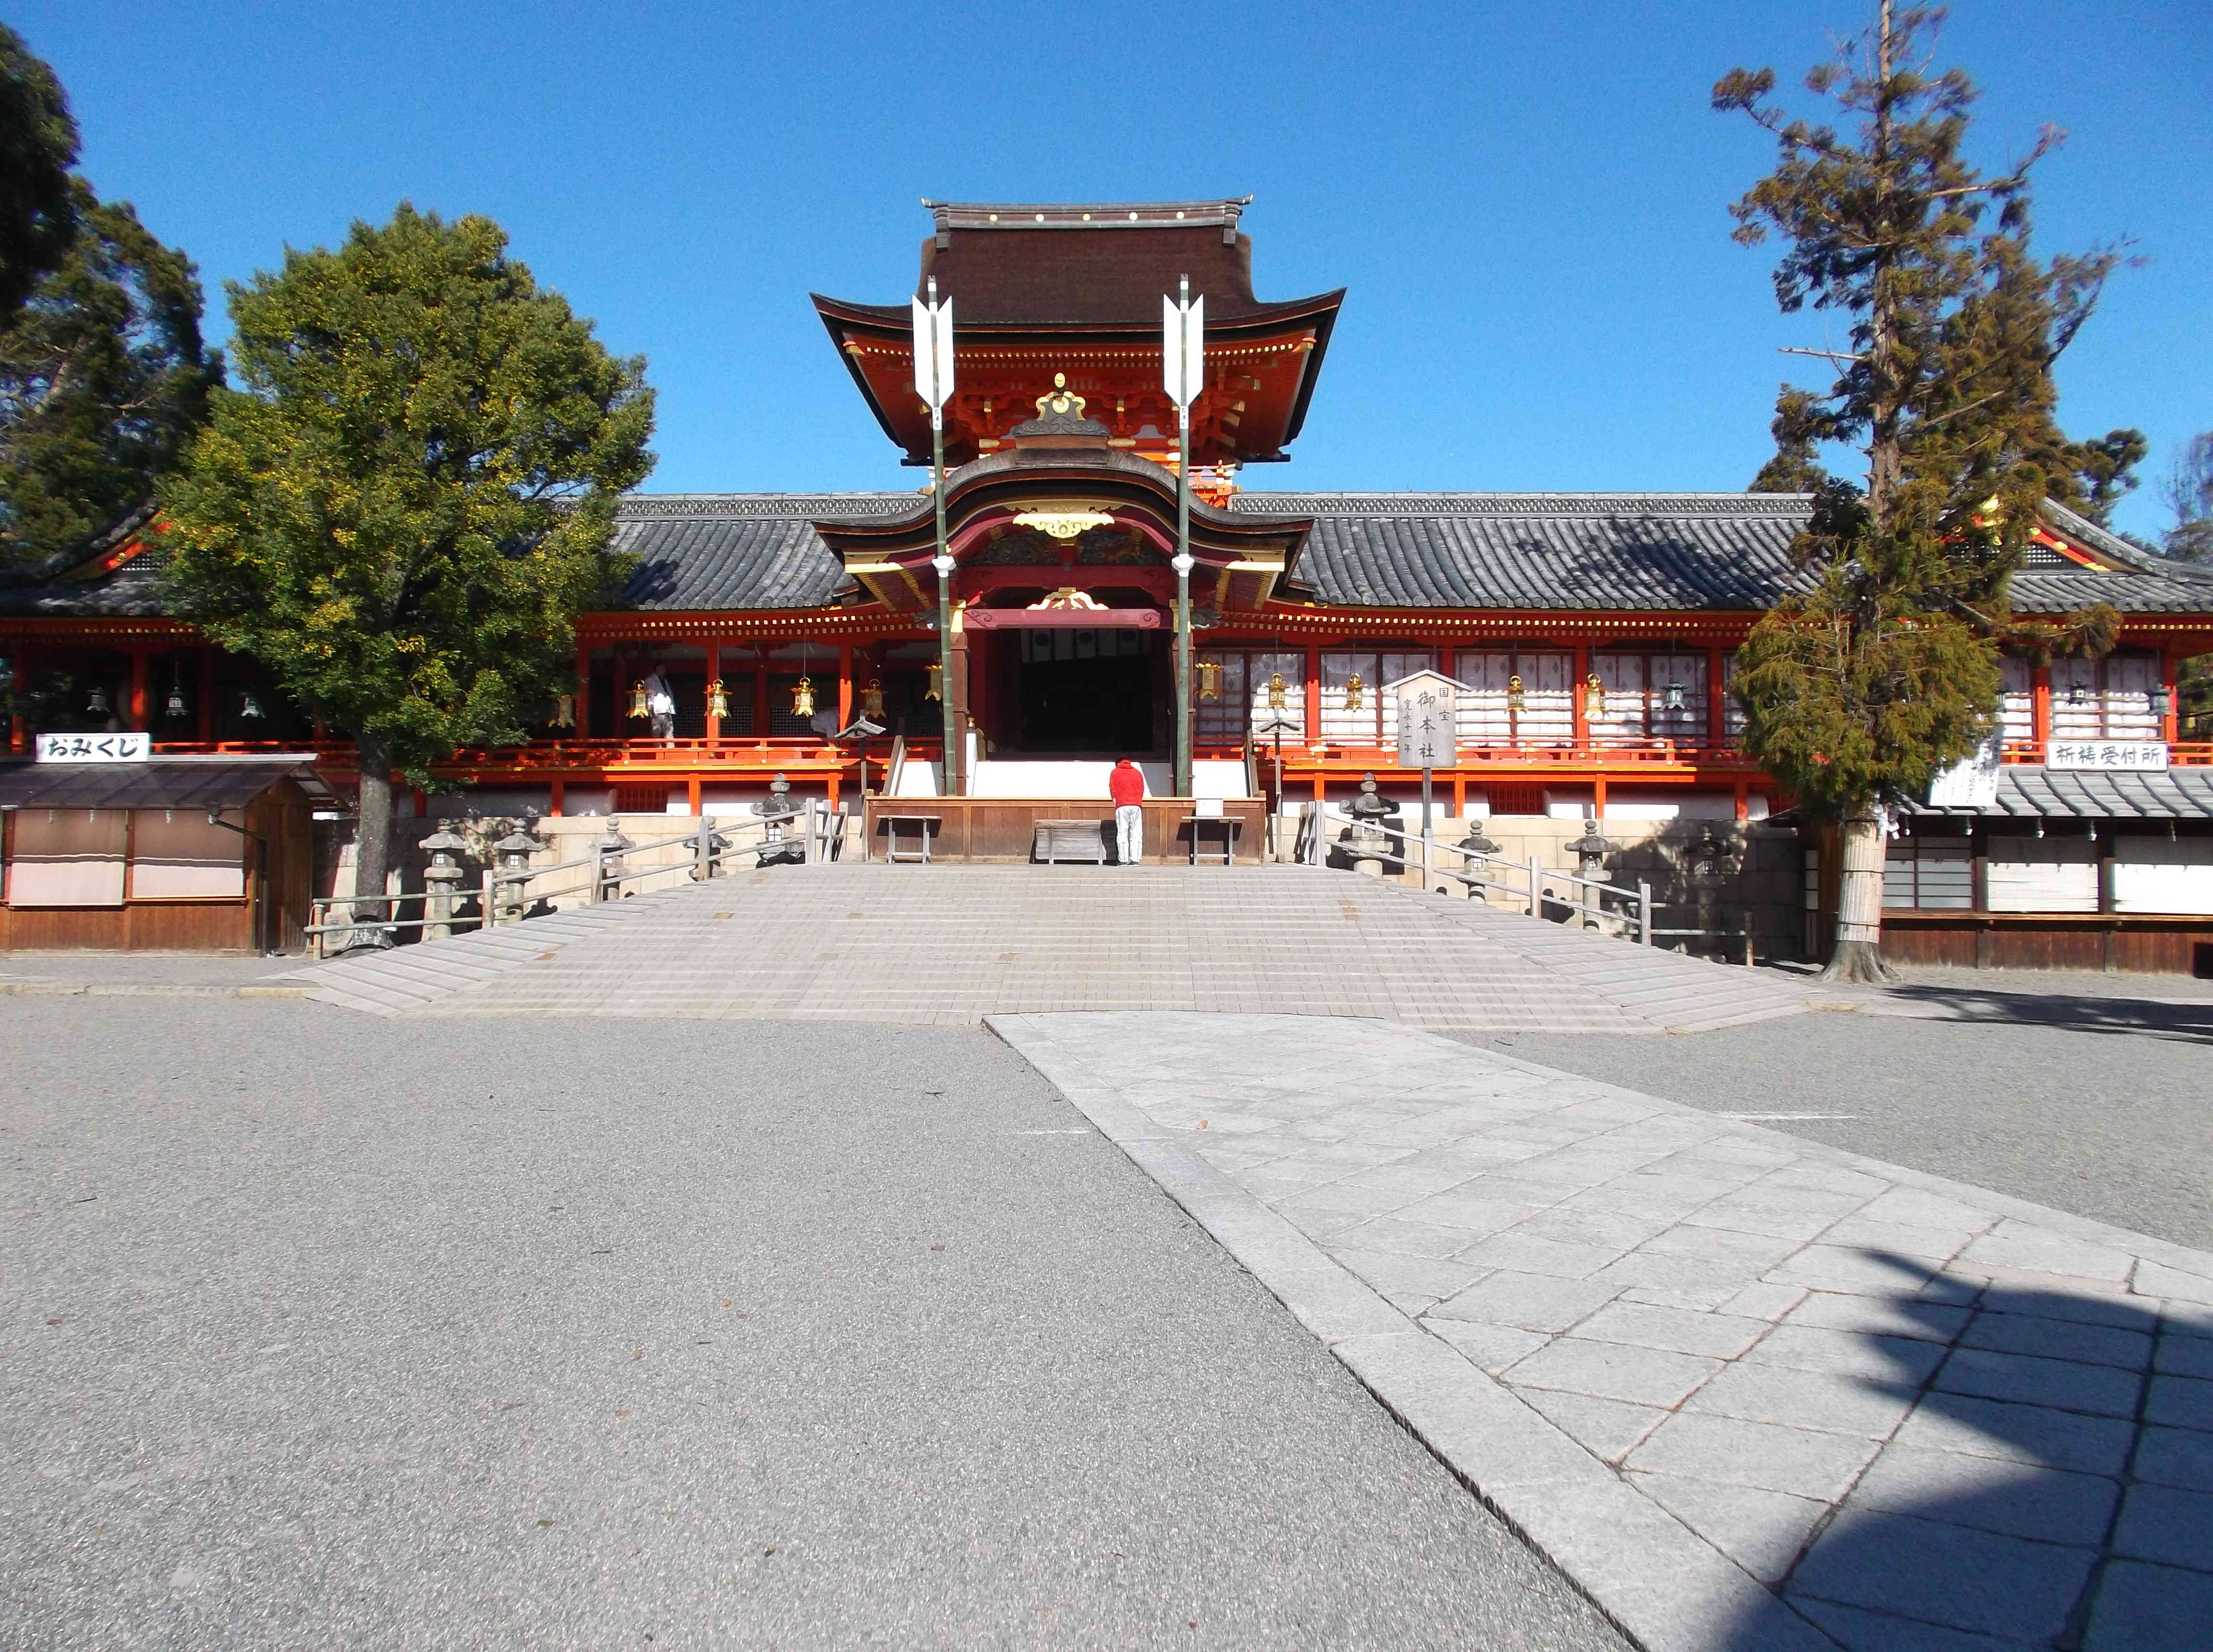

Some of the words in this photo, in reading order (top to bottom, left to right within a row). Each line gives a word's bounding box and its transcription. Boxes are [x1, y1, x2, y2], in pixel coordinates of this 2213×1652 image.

[1439, 687, 1450, 721] 国宝
[1403, 699, 1412, 753] 寛永十一年
[1417, 690, 1436, 758] 御本社
[49, 736, 139, 757] おみくじ
[2055, 745, 2161, 765] 祈祷受付所
